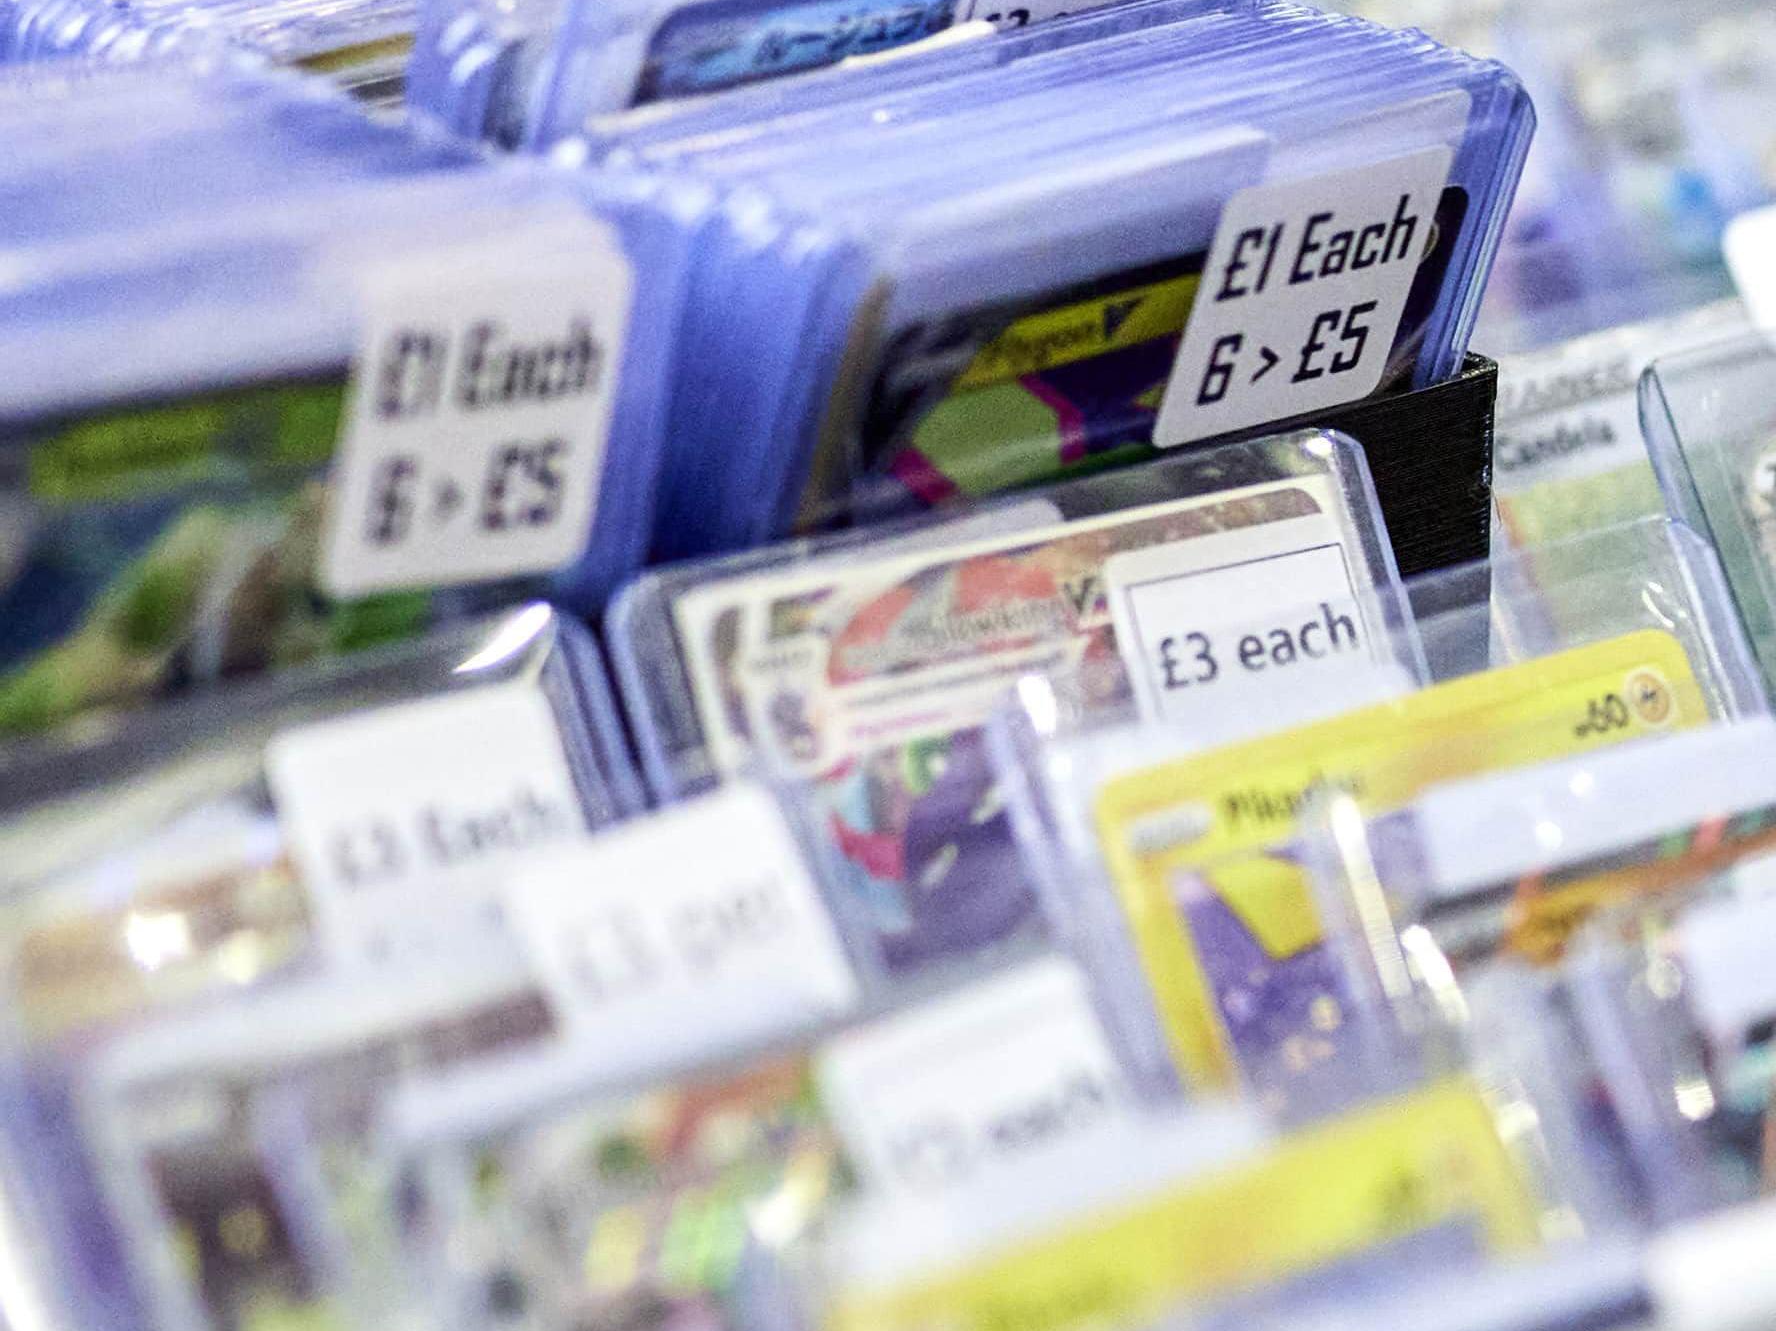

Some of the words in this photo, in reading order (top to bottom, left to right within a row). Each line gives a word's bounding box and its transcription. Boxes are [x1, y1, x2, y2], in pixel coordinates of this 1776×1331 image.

[1213, 225, 1284, 305] £1
[1290, 192, 1420, 286] Each
[1196, 333, 1243, 406] 6
[1293, 301, 1379, 384] £5
[1159, 628, 1218, 692] £3
[1237, 604, 1357, 671] each
